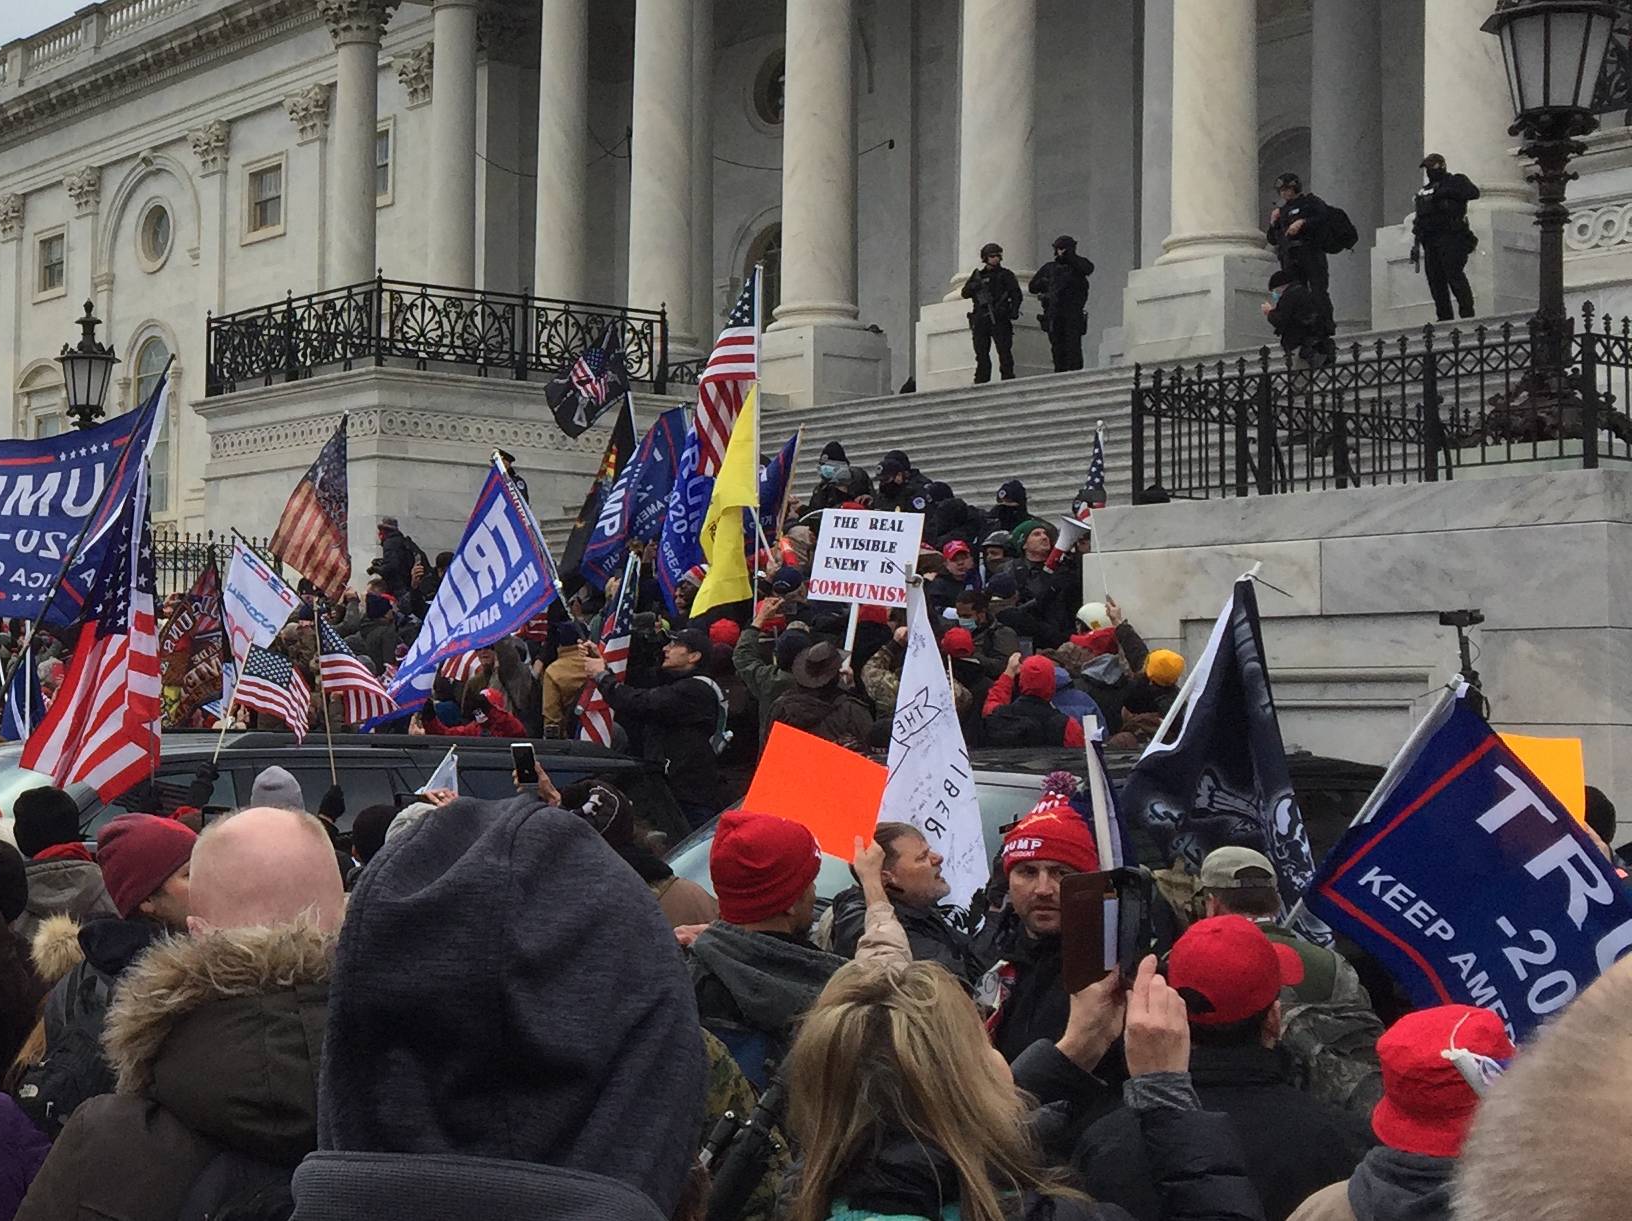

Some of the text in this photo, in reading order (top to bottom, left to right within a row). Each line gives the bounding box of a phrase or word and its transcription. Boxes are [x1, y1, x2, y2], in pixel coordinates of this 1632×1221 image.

[833, 516, 905, 532] THE REAL
[829, 536, 898, 554] INVISIBLE
[824, 556, 895, 575] ENEMY IS
[809, 578, 908, 603] COMMUNISM
[1358, 865, 1457, 942] KEEP
